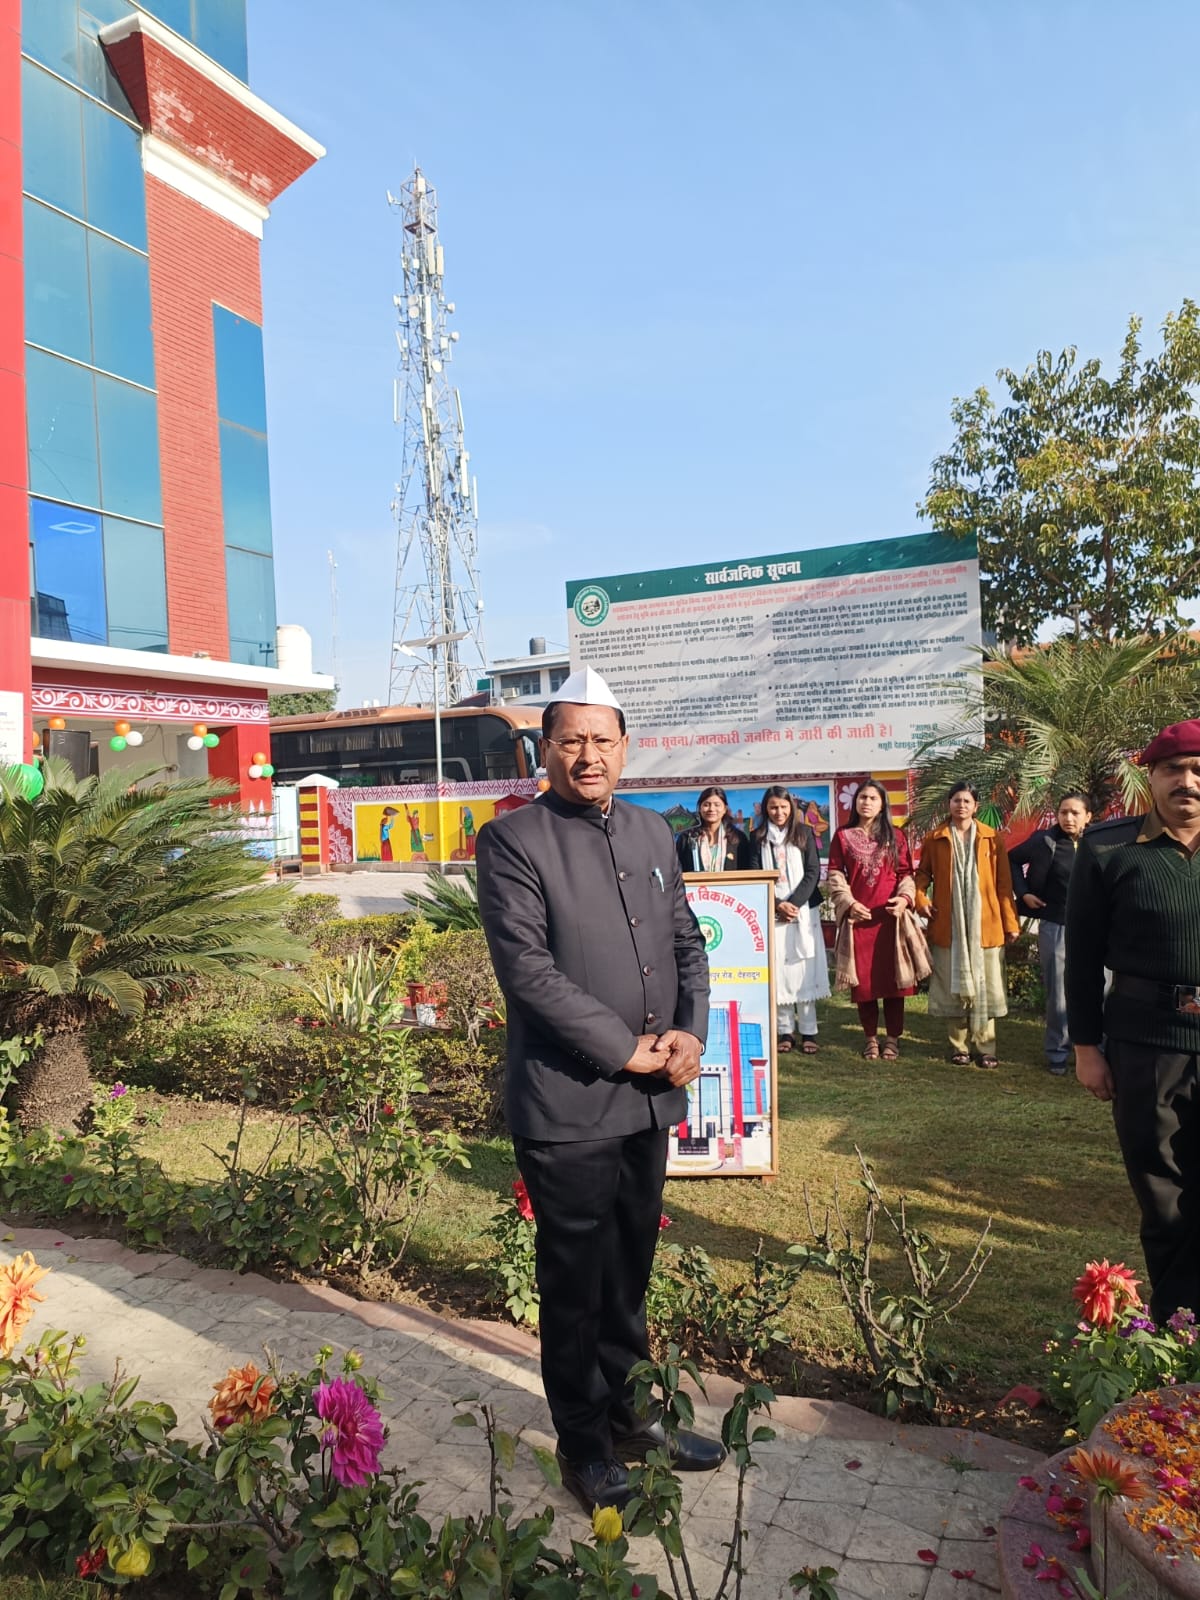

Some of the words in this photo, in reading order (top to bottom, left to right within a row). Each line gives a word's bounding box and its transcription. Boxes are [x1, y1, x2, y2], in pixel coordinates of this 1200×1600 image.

[704, 564, 763, 584] सार्वजनिक
[766, 561, 801, 580] सूचना
[638, 737, 658, 748] उक्त
[744, 728, 781, 743] जनहित
[785, 726, 795, 741] में
[799, 726, 823, 740] जारी
[826, 725, 842, 739] की
[847, 723, 874, 738] जाती
[697, 885, 735, 907] विकास
[734, 902, 764, 951] प्राधिकरण
